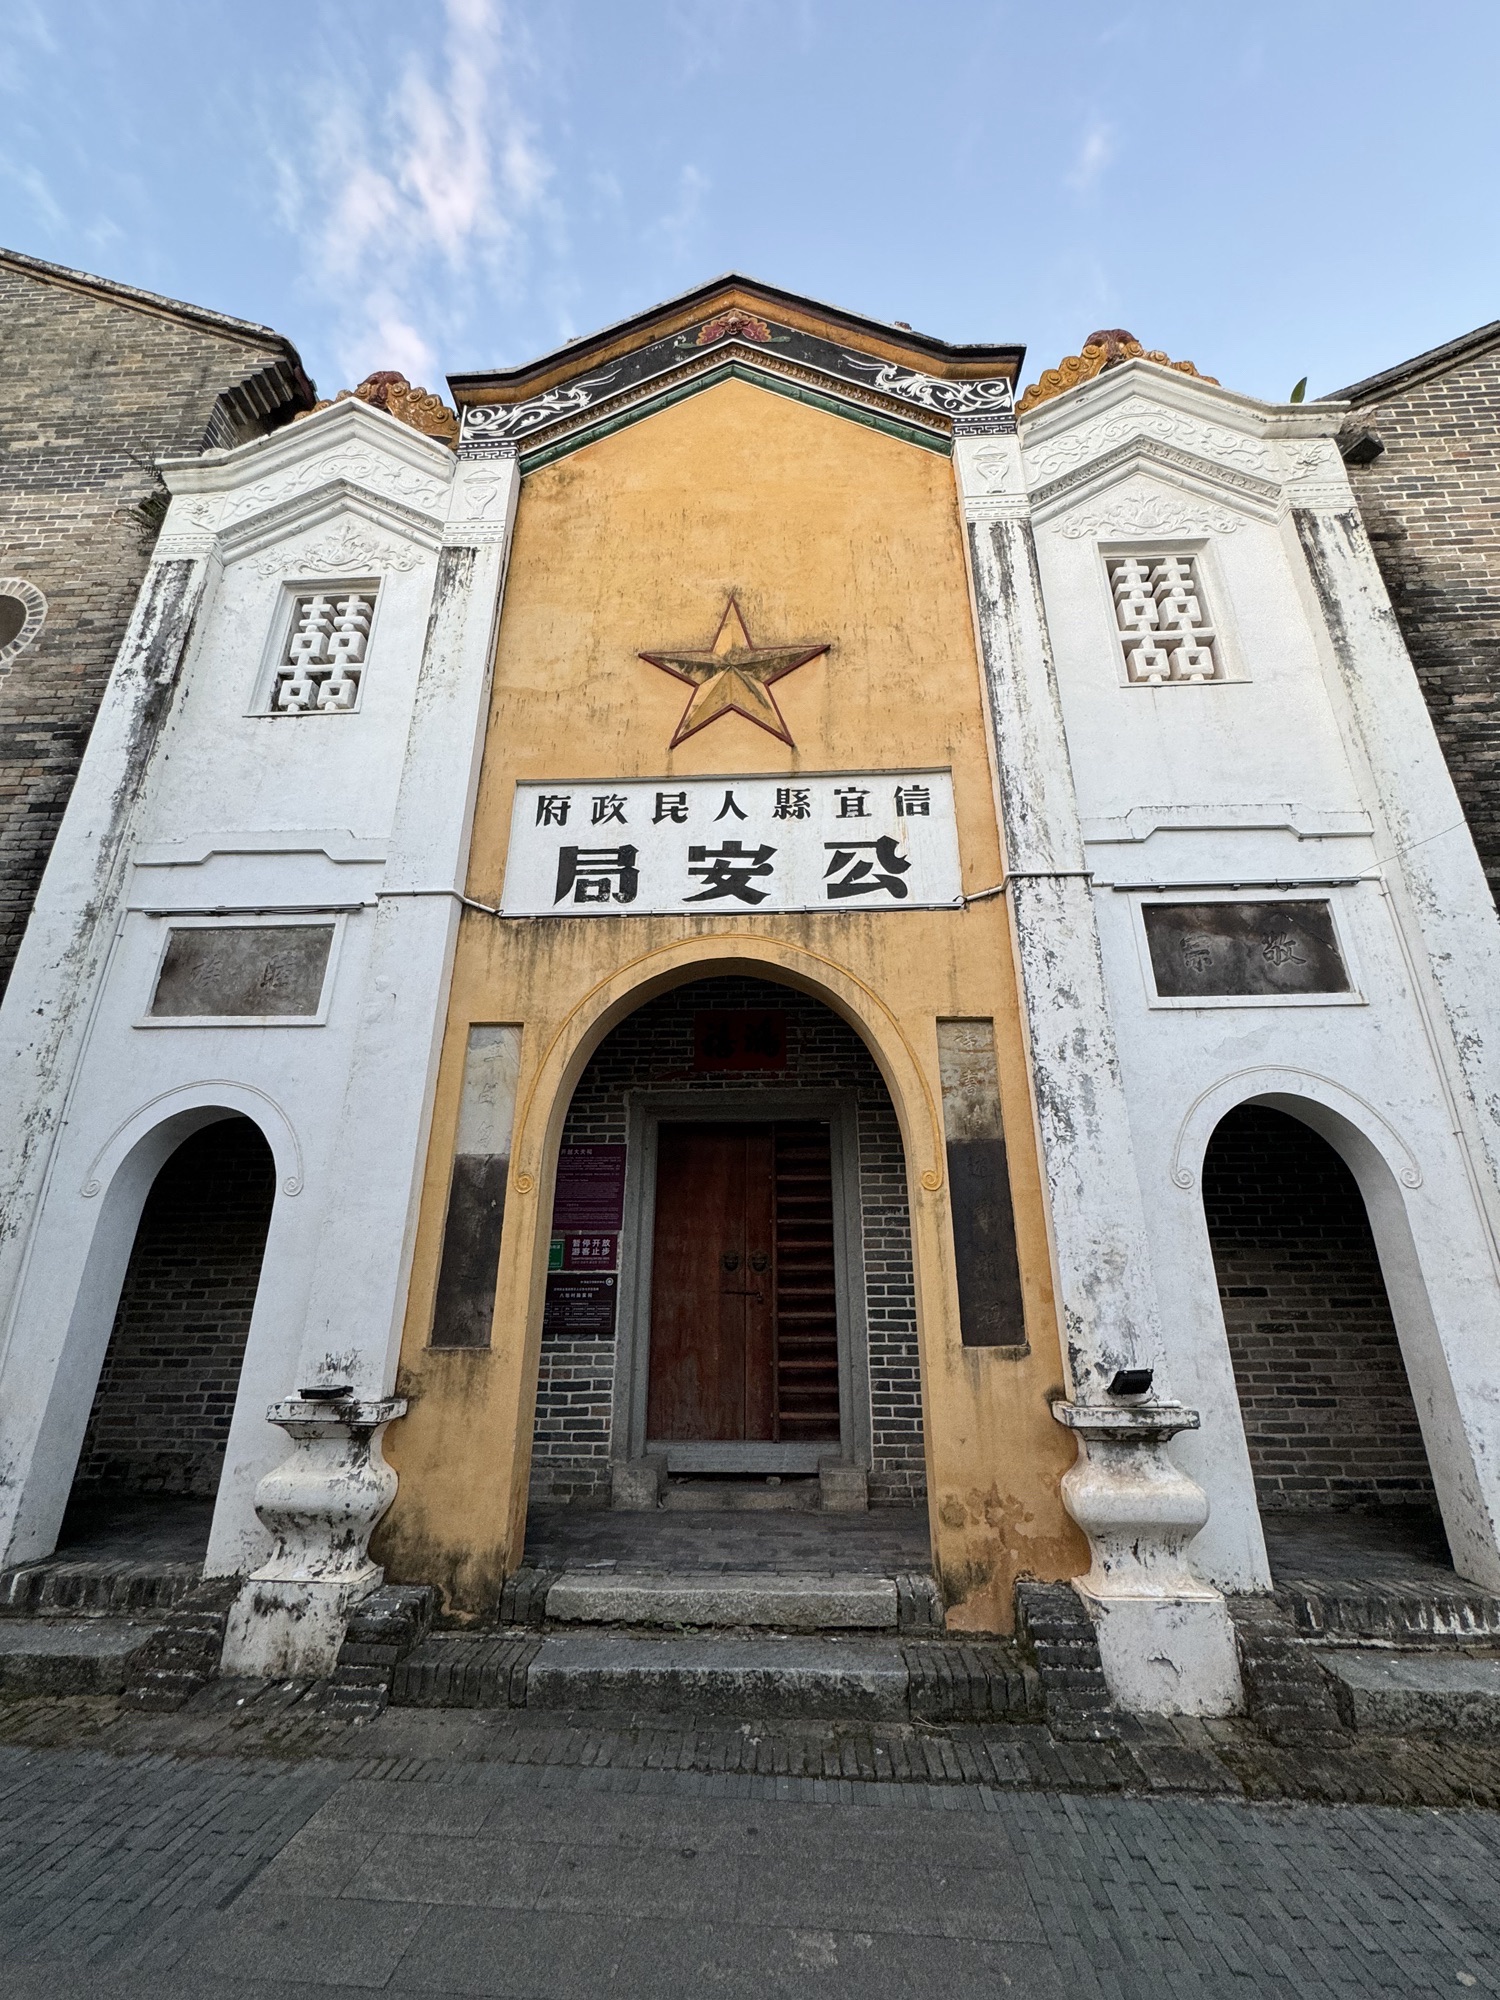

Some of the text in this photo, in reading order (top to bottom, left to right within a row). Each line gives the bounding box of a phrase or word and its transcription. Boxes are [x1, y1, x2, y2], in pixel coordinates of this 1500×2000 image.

[535, 784, 931, 827] 信宜縣人民政府
[552, 834, 913, 906] 公安局
[571, 1247, 610, 1256] 游客止步
[572, 1238, 611, 1247] 暂停开放
